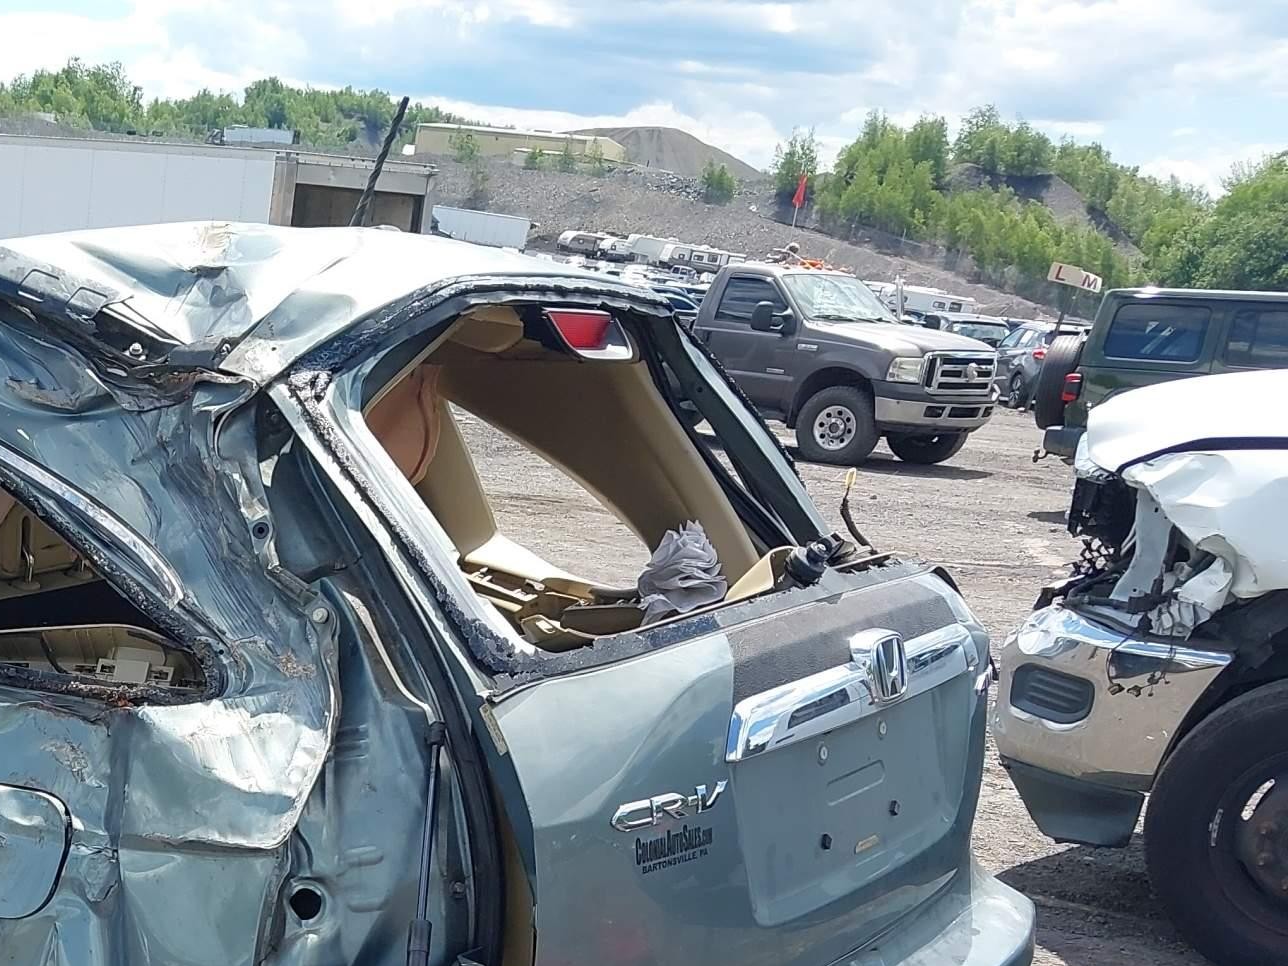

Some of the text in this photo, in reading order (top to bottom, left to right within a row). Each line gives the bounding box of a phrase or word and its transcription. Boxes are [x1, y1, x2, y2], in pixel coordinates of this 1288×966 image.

[1055, 265, 1097, 289] L M
[610, 778, 729, 832] CR-V
[699, 847, 709, 857] PA
